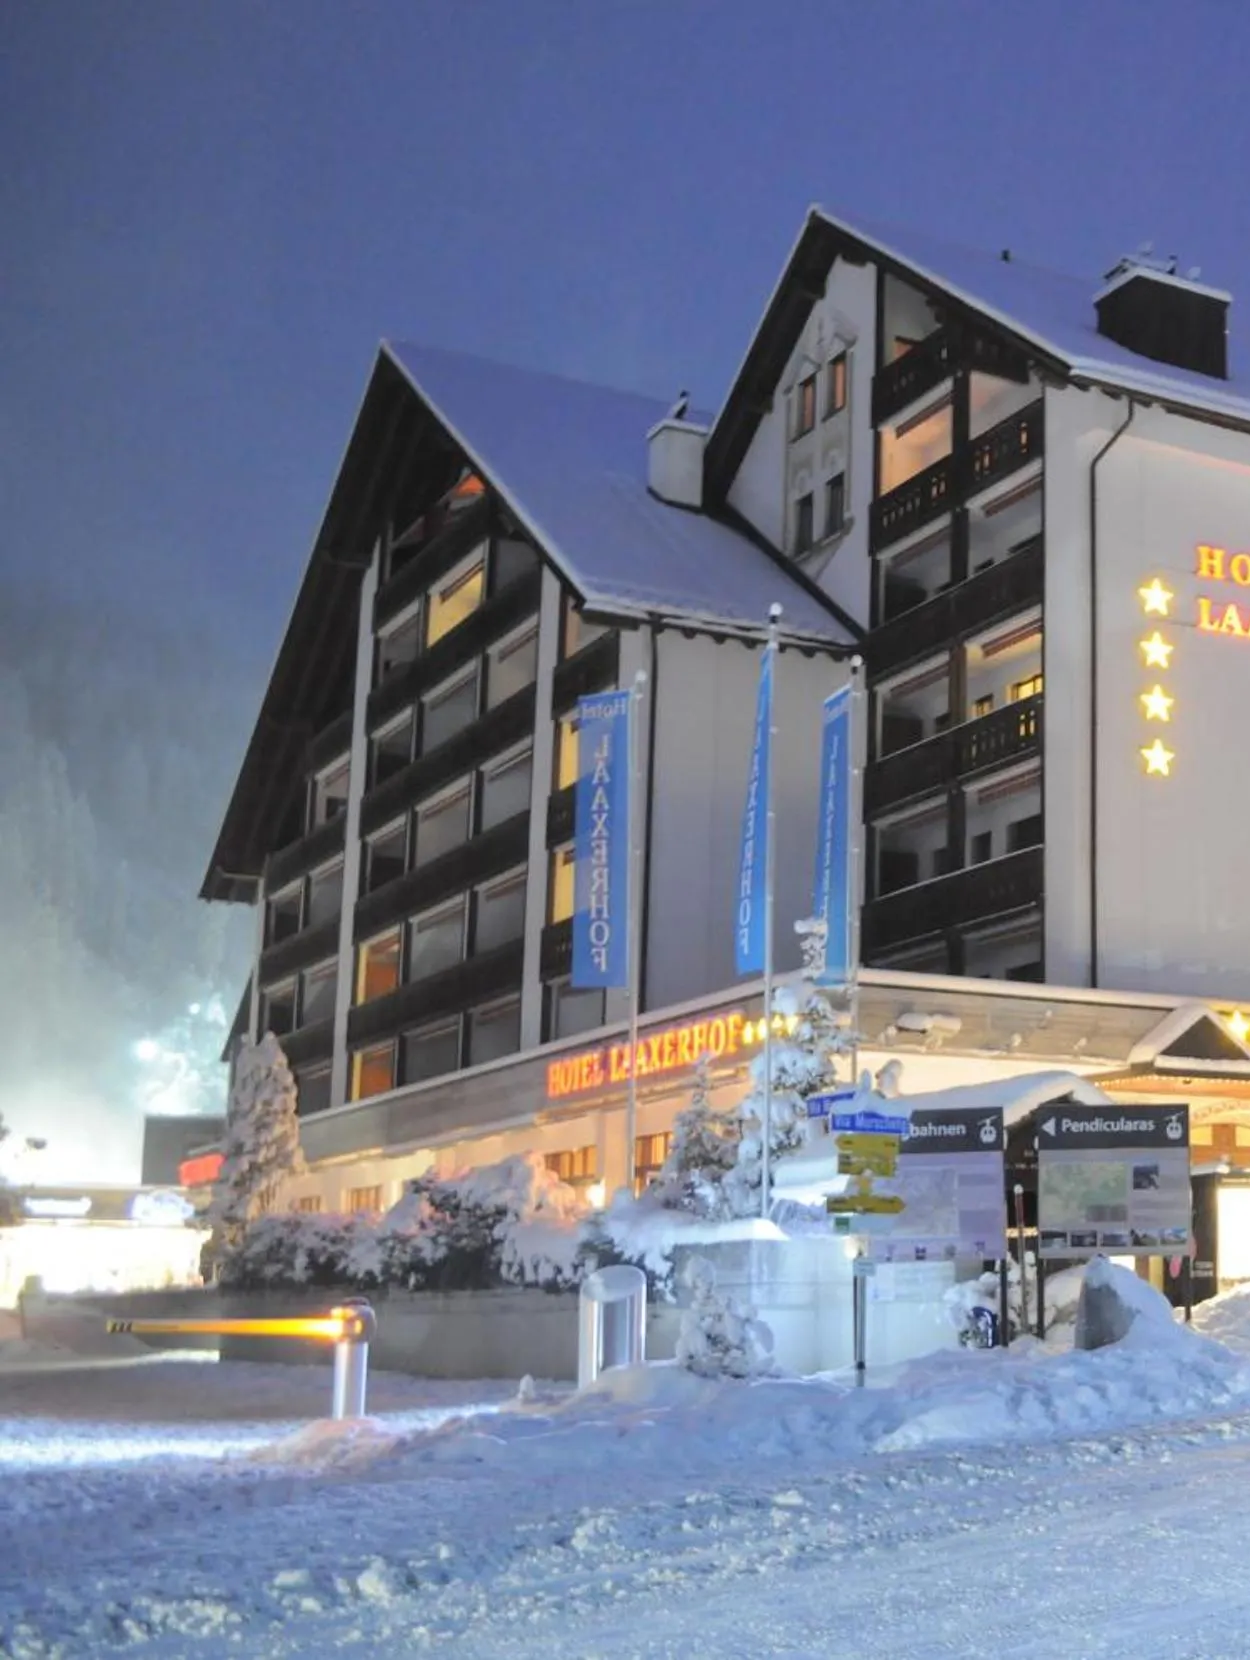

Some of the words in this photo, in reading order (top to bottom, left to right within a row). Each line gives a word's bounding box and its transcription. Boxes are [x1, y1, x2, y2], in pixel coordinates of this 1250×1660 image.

[547, 1052, 604, 1098] HOTEL
[609, 1012, 745, 1083] LAAXERHOF
[1061, 1116, 1155, 1134] Pendicularas
